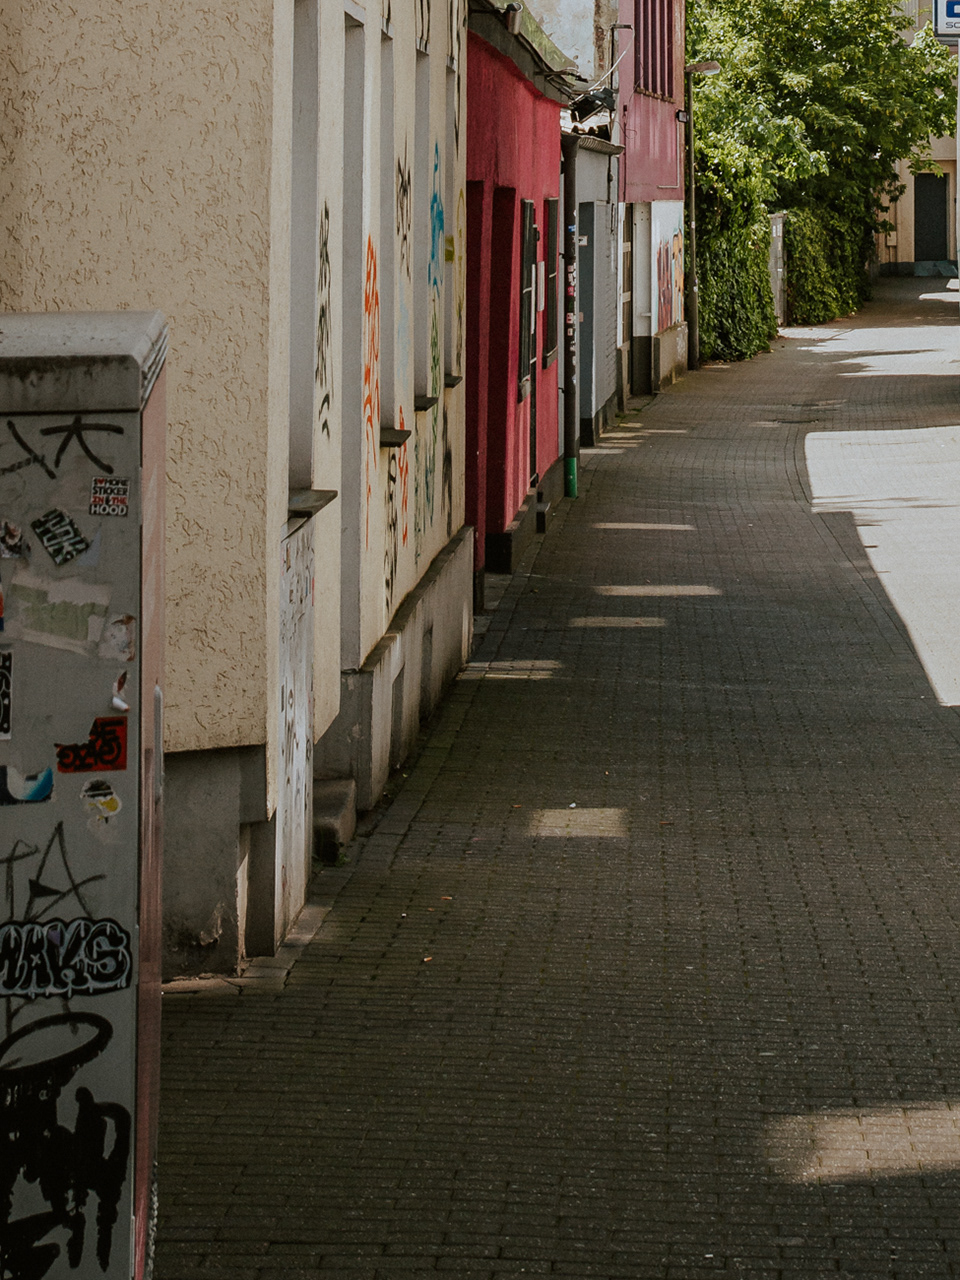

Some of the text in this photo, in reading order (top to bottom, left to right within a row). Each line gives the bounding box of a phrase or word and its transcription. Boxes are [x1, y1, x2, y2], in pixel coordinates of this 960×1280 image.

[92, 485, 128, 496] STICKER
[92, 495, 127, 504] IN THE
[91, 504, 127, 515] HOOD
